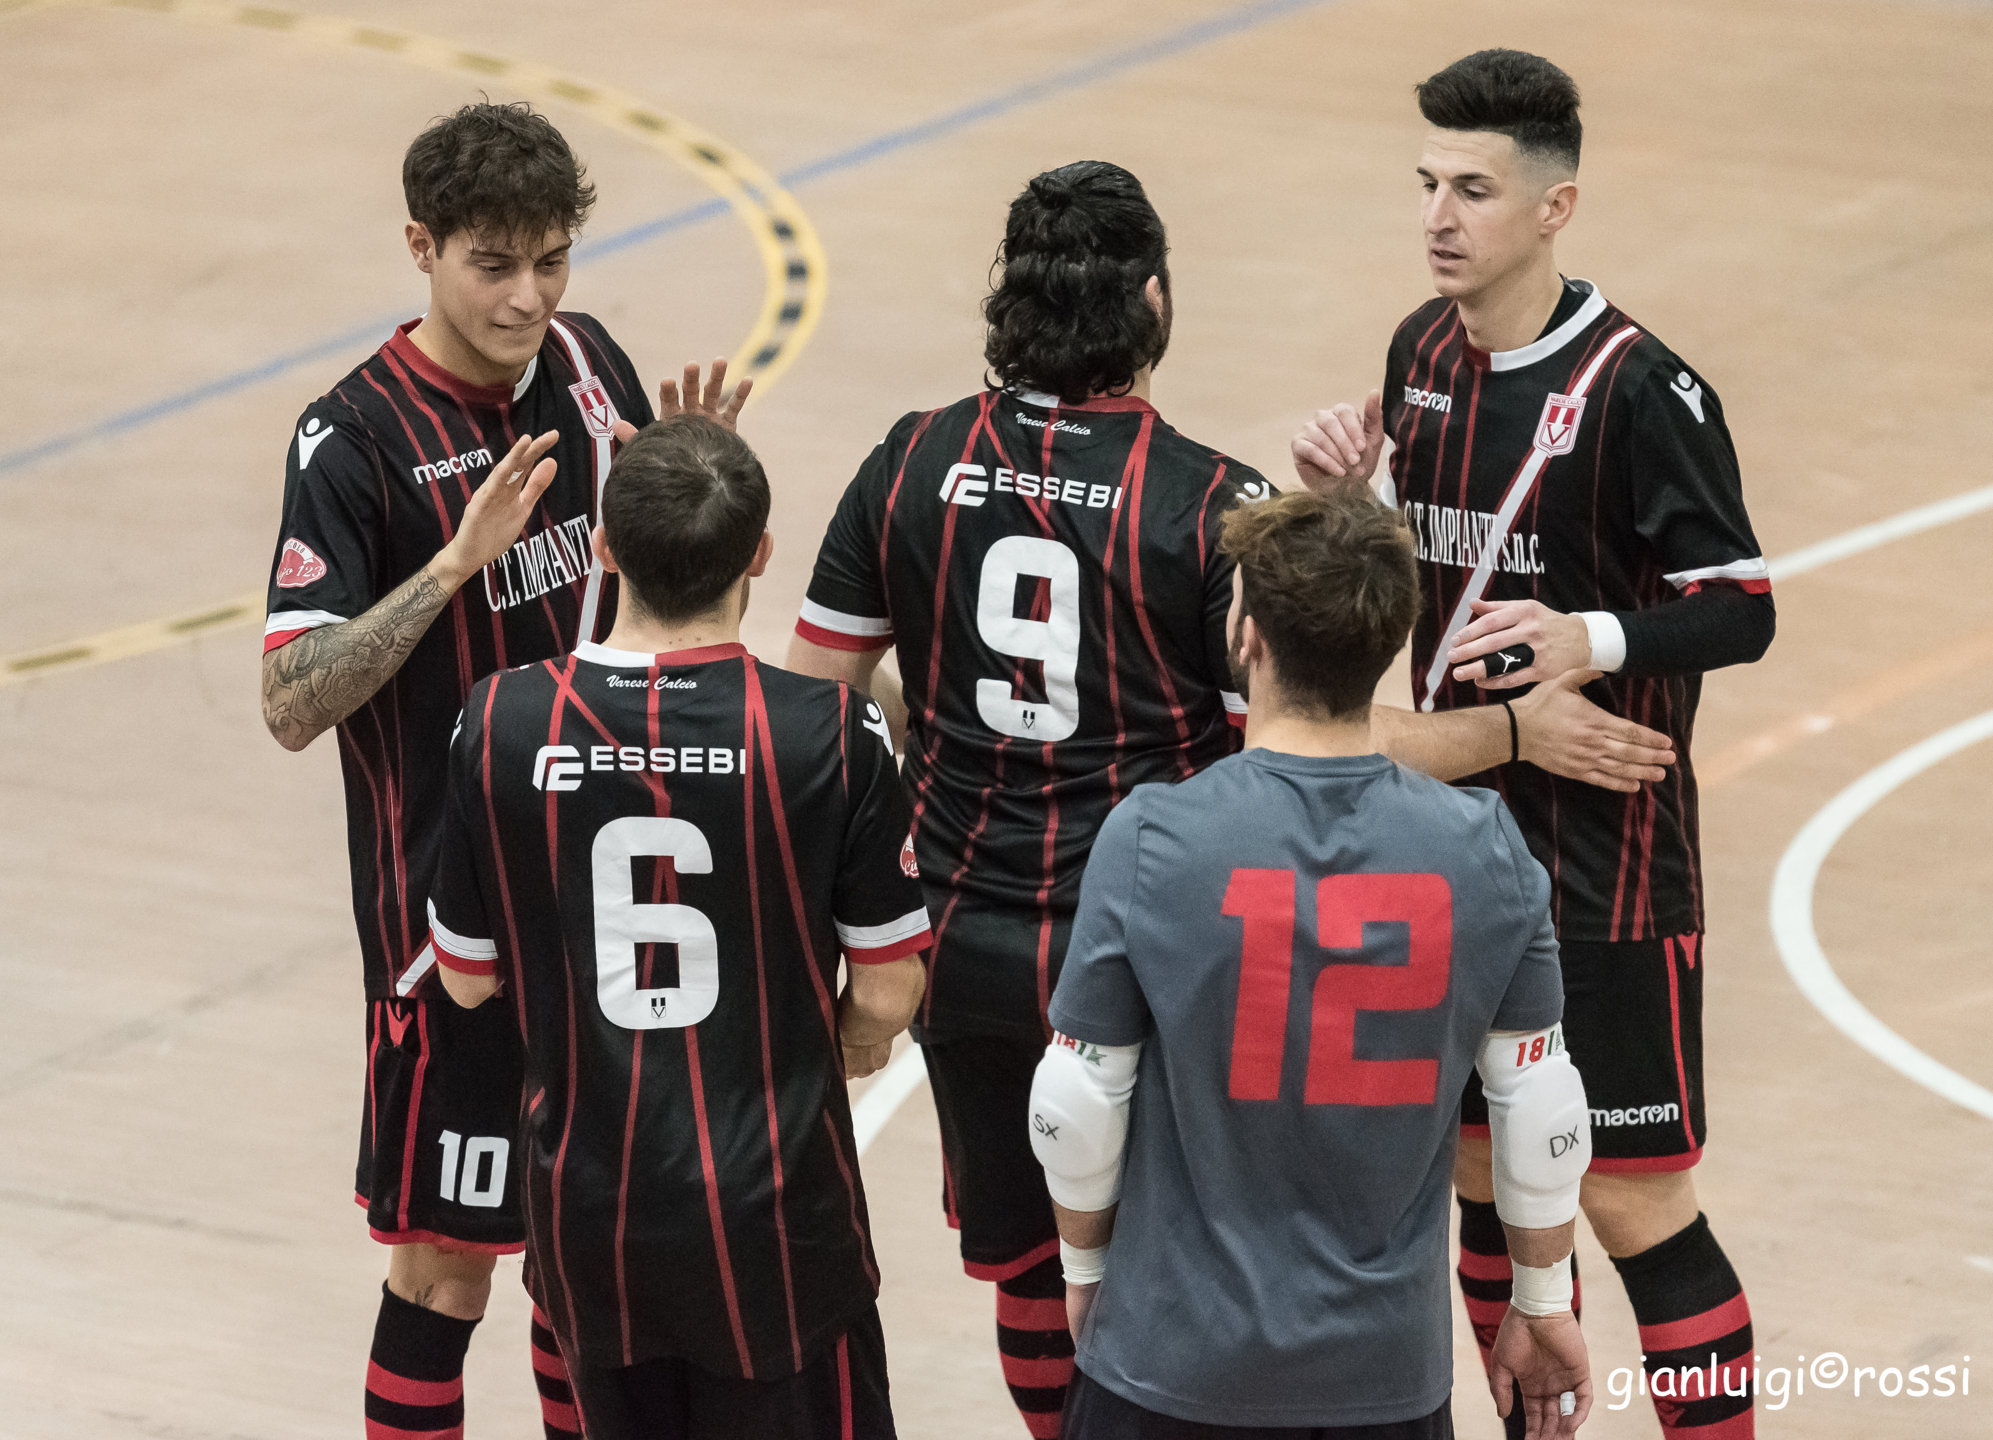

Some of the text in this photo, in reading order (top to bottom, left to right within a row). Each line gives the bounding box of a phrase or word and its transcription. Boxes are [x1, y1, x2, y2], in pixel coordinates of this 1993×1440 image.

[1404, 385, 1452, 413] macron
[1015, 412, 1092, 436] Varese Calcio
[413, 448, 492, 484] macron
[994, 467, 1122, 509] ESSEBI
[976, 535, 1081, 742] 9
[606, 674, 698, 691] Varese Calcio
[590, 745, 746, 775] ESSEBI
[591, 816, 719, 1030] 6
[1221, 867, 1453, 1106] 12
[1588, 1102, 1679, 1127] macron
[438, 1129, 510, 1208] 10
